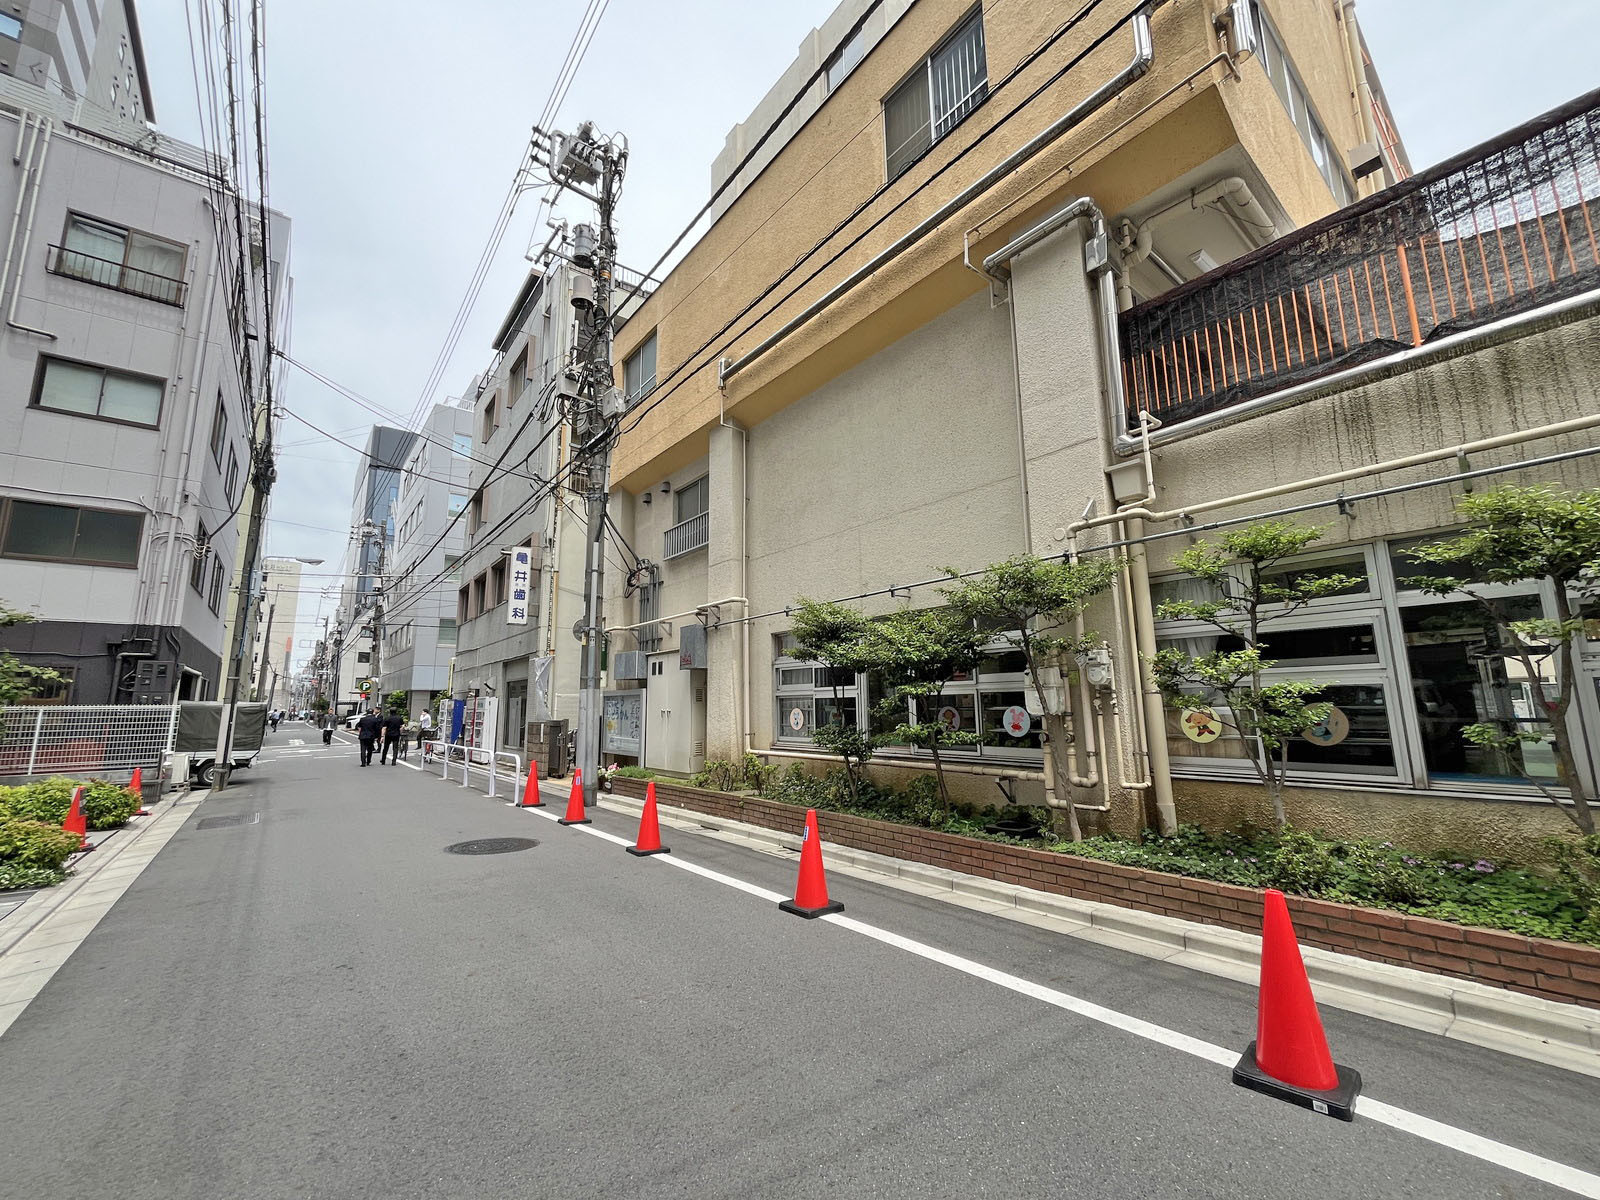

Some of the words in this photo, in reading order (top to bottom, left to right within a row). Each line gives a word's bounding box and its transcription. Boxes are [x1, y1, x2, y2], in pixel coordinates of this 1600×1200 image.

[511, 551, 529, 620] 亀井歯科
[362, 682, 370, 691] P
